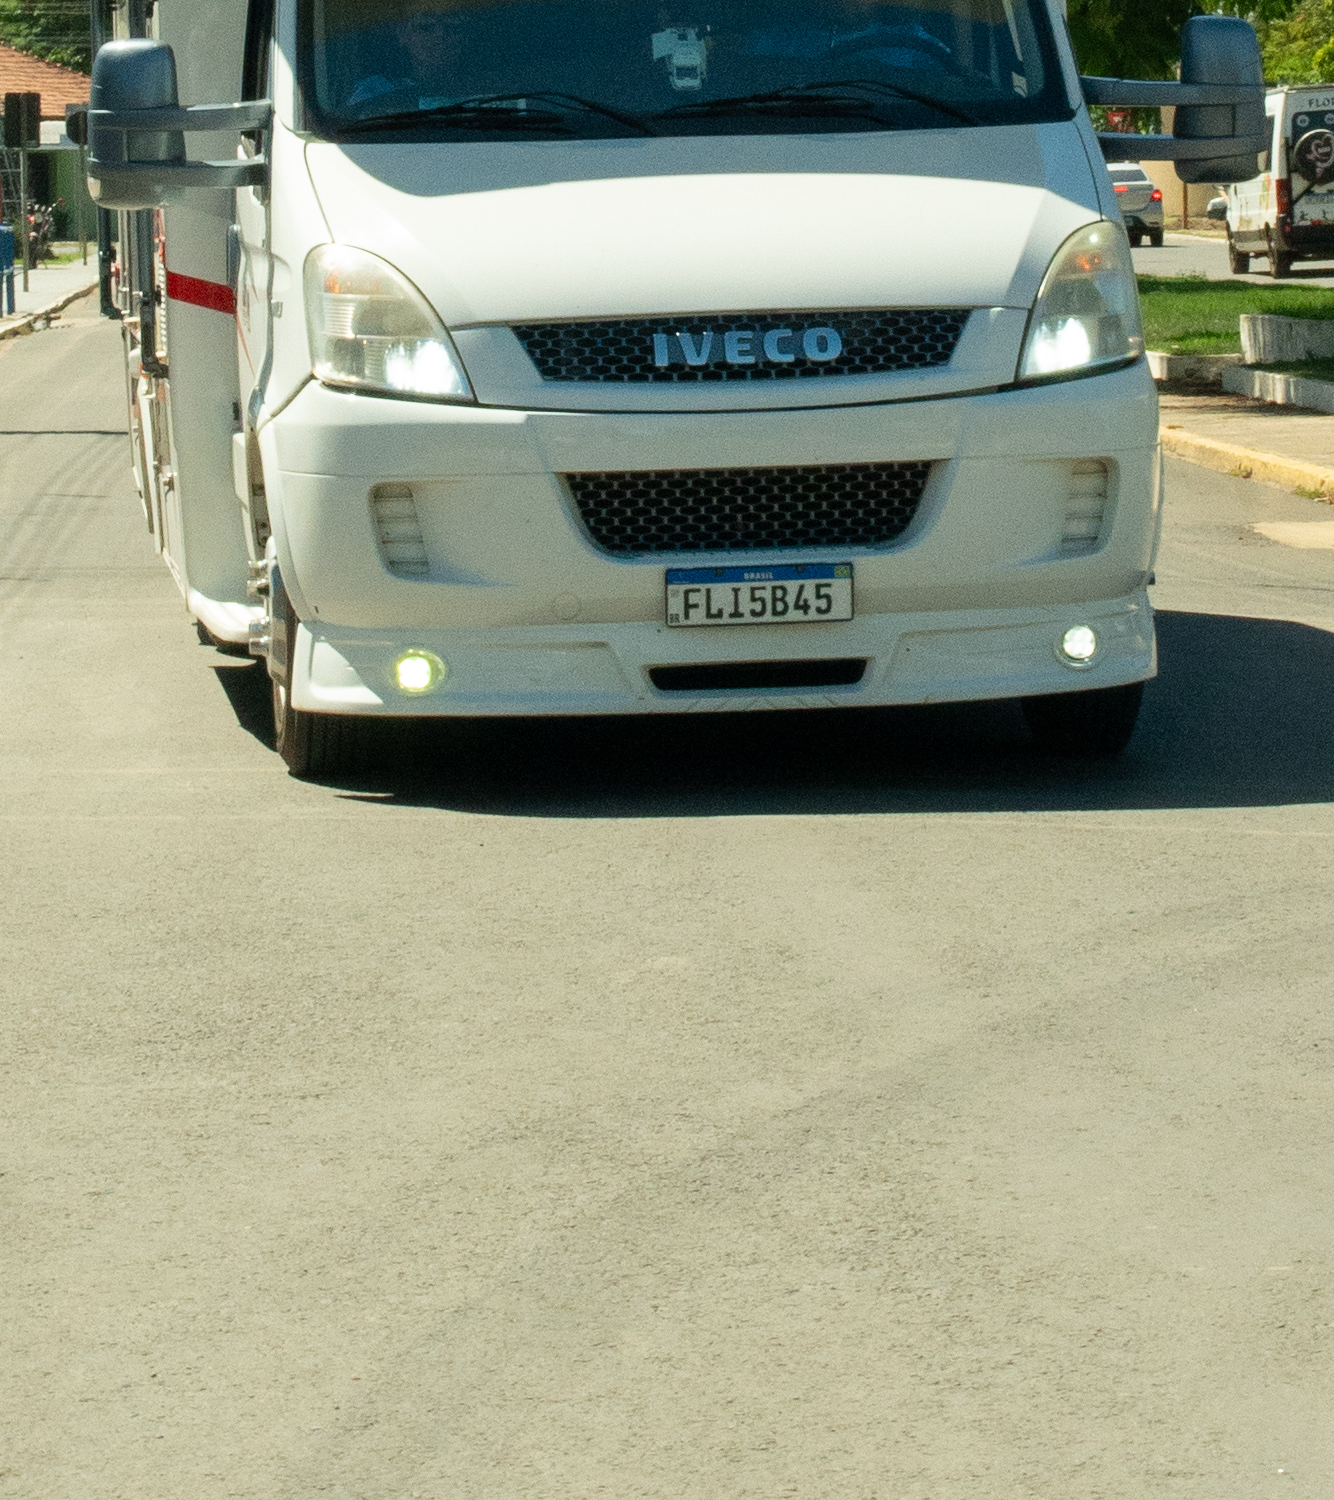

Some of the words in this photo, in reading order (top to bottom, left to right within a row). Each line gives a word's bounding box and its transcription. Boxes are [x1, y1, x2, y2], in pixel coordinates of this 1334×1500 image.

[652, 327, 842, 367] IVECO
[743, 571, 774, 581] BRASIL
[683, 582, 833, 621] FLI5B45
